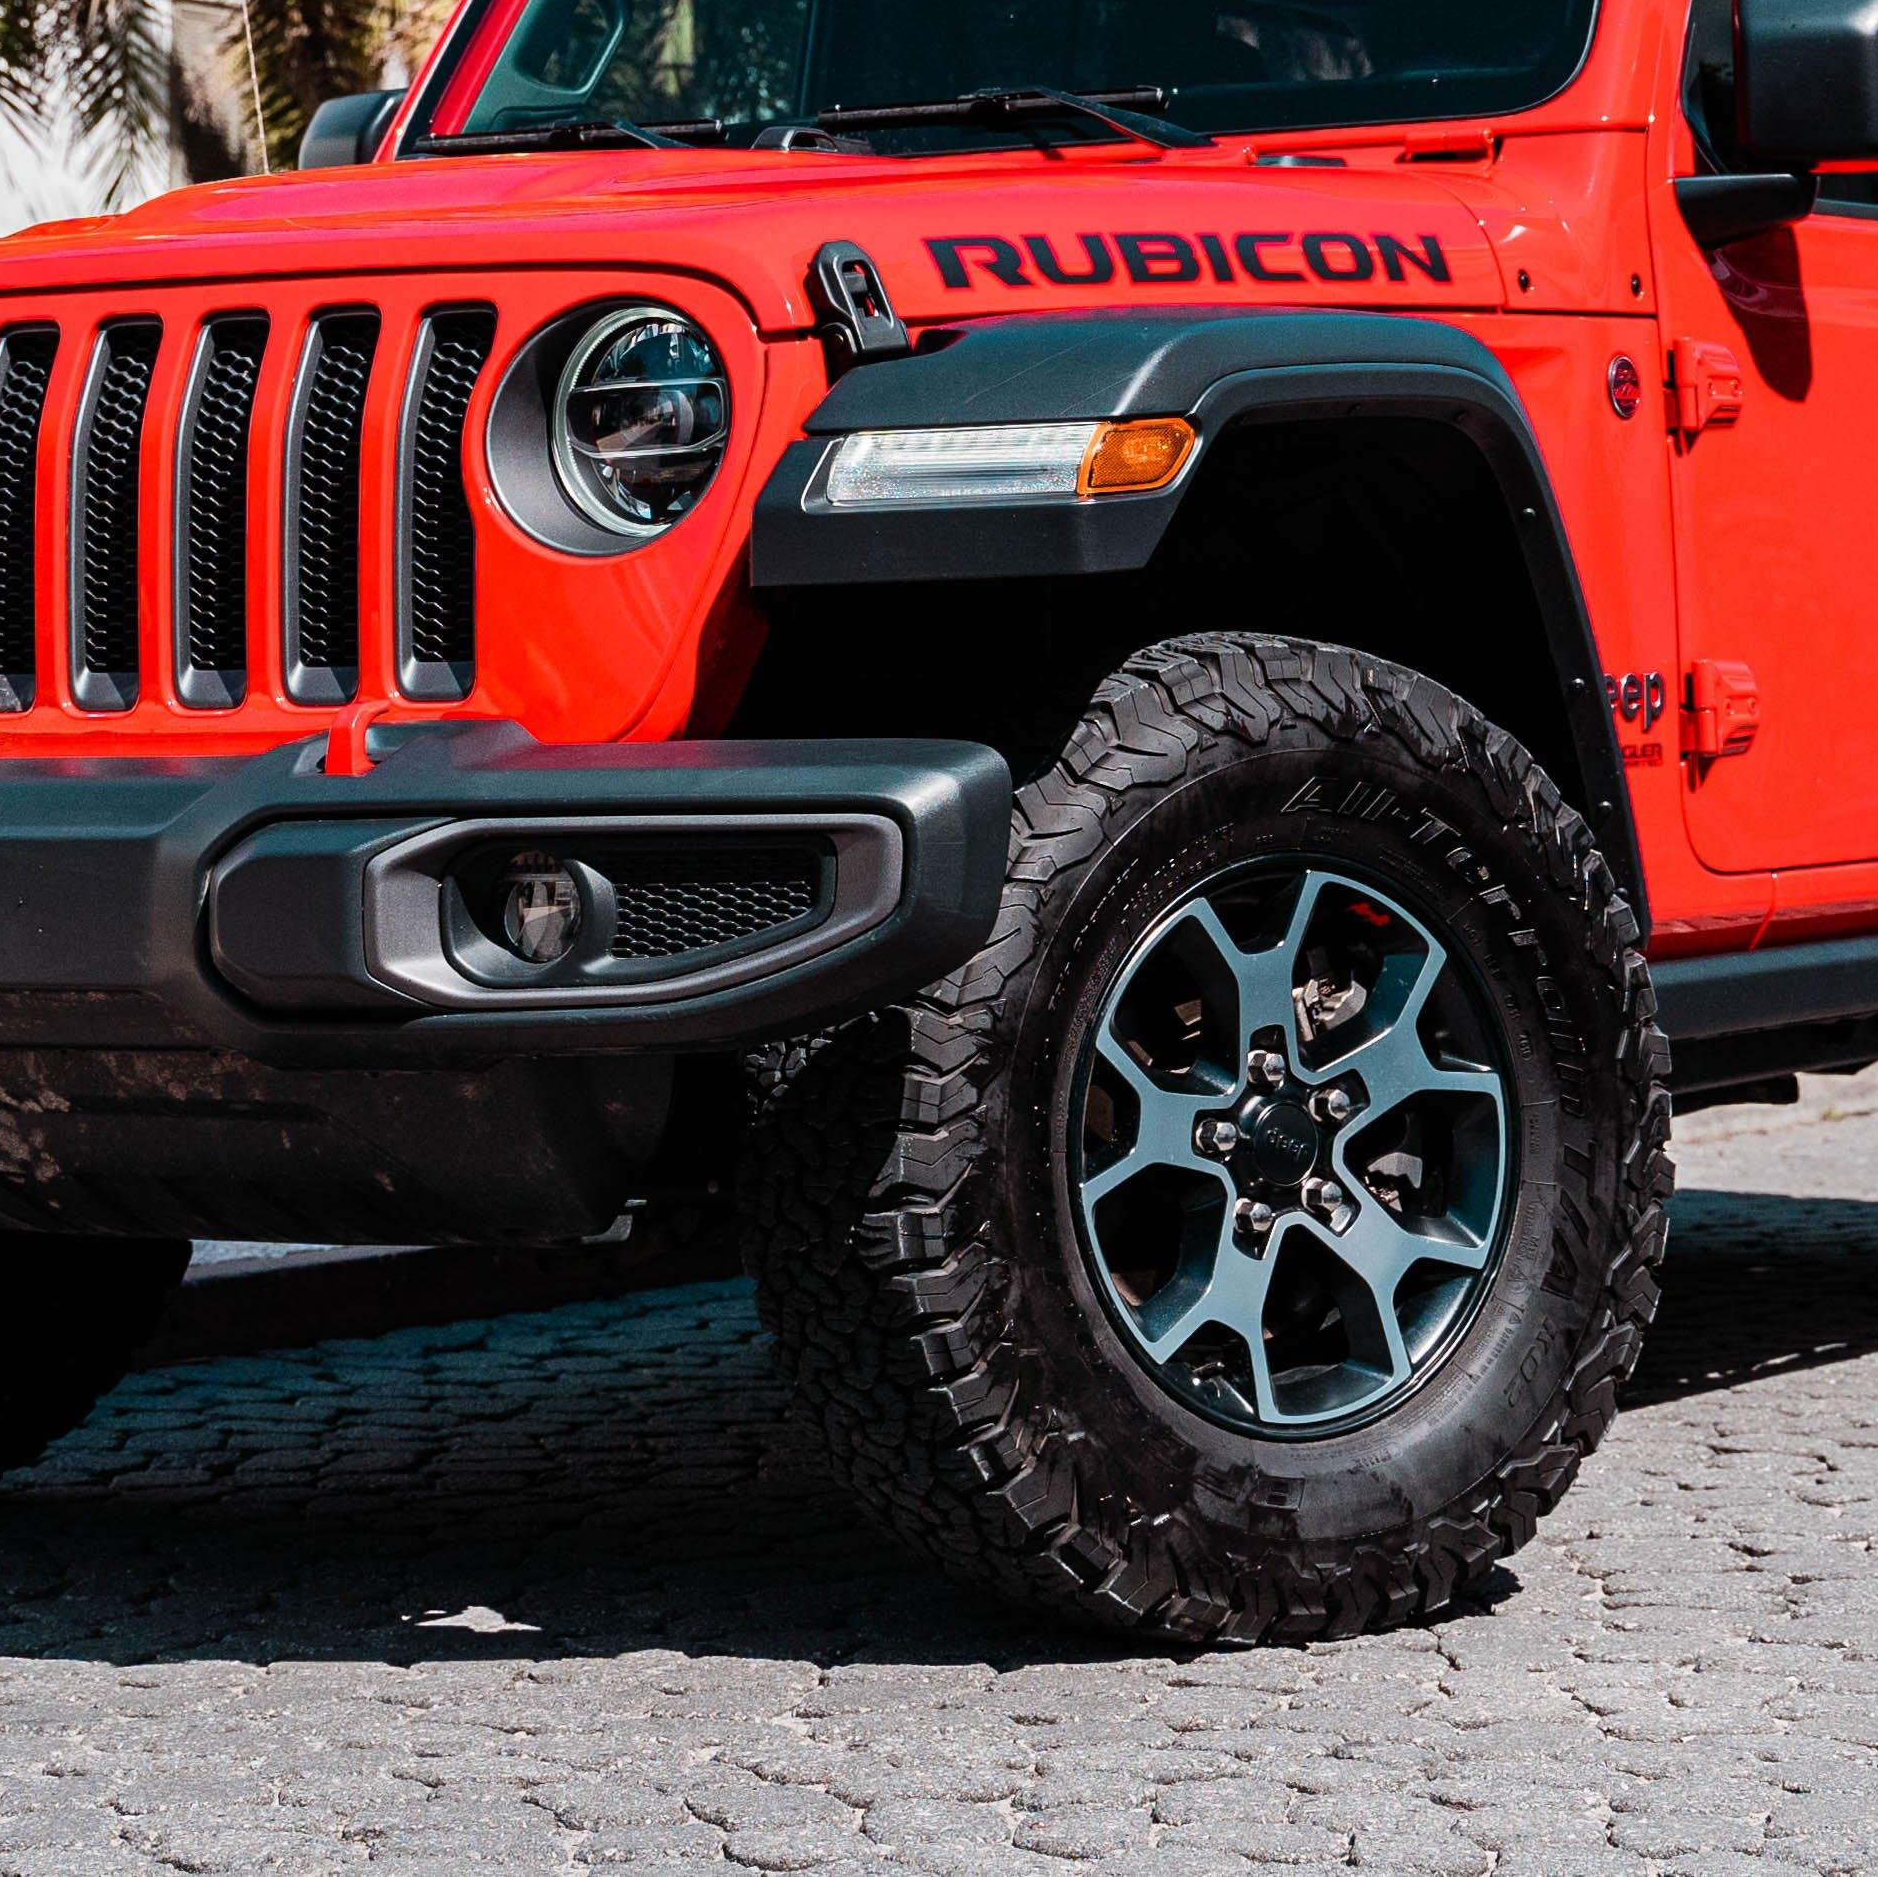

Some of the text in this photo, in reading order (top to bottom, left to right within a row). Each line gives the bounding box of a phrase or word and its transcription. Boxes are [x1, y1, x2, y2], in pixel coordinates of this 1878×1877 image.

[923, 233, 1453, 289] RUBICON
[1603, 671, 1665, 732] eep
[1280, 775, 1587, 1118] All-Terrain
